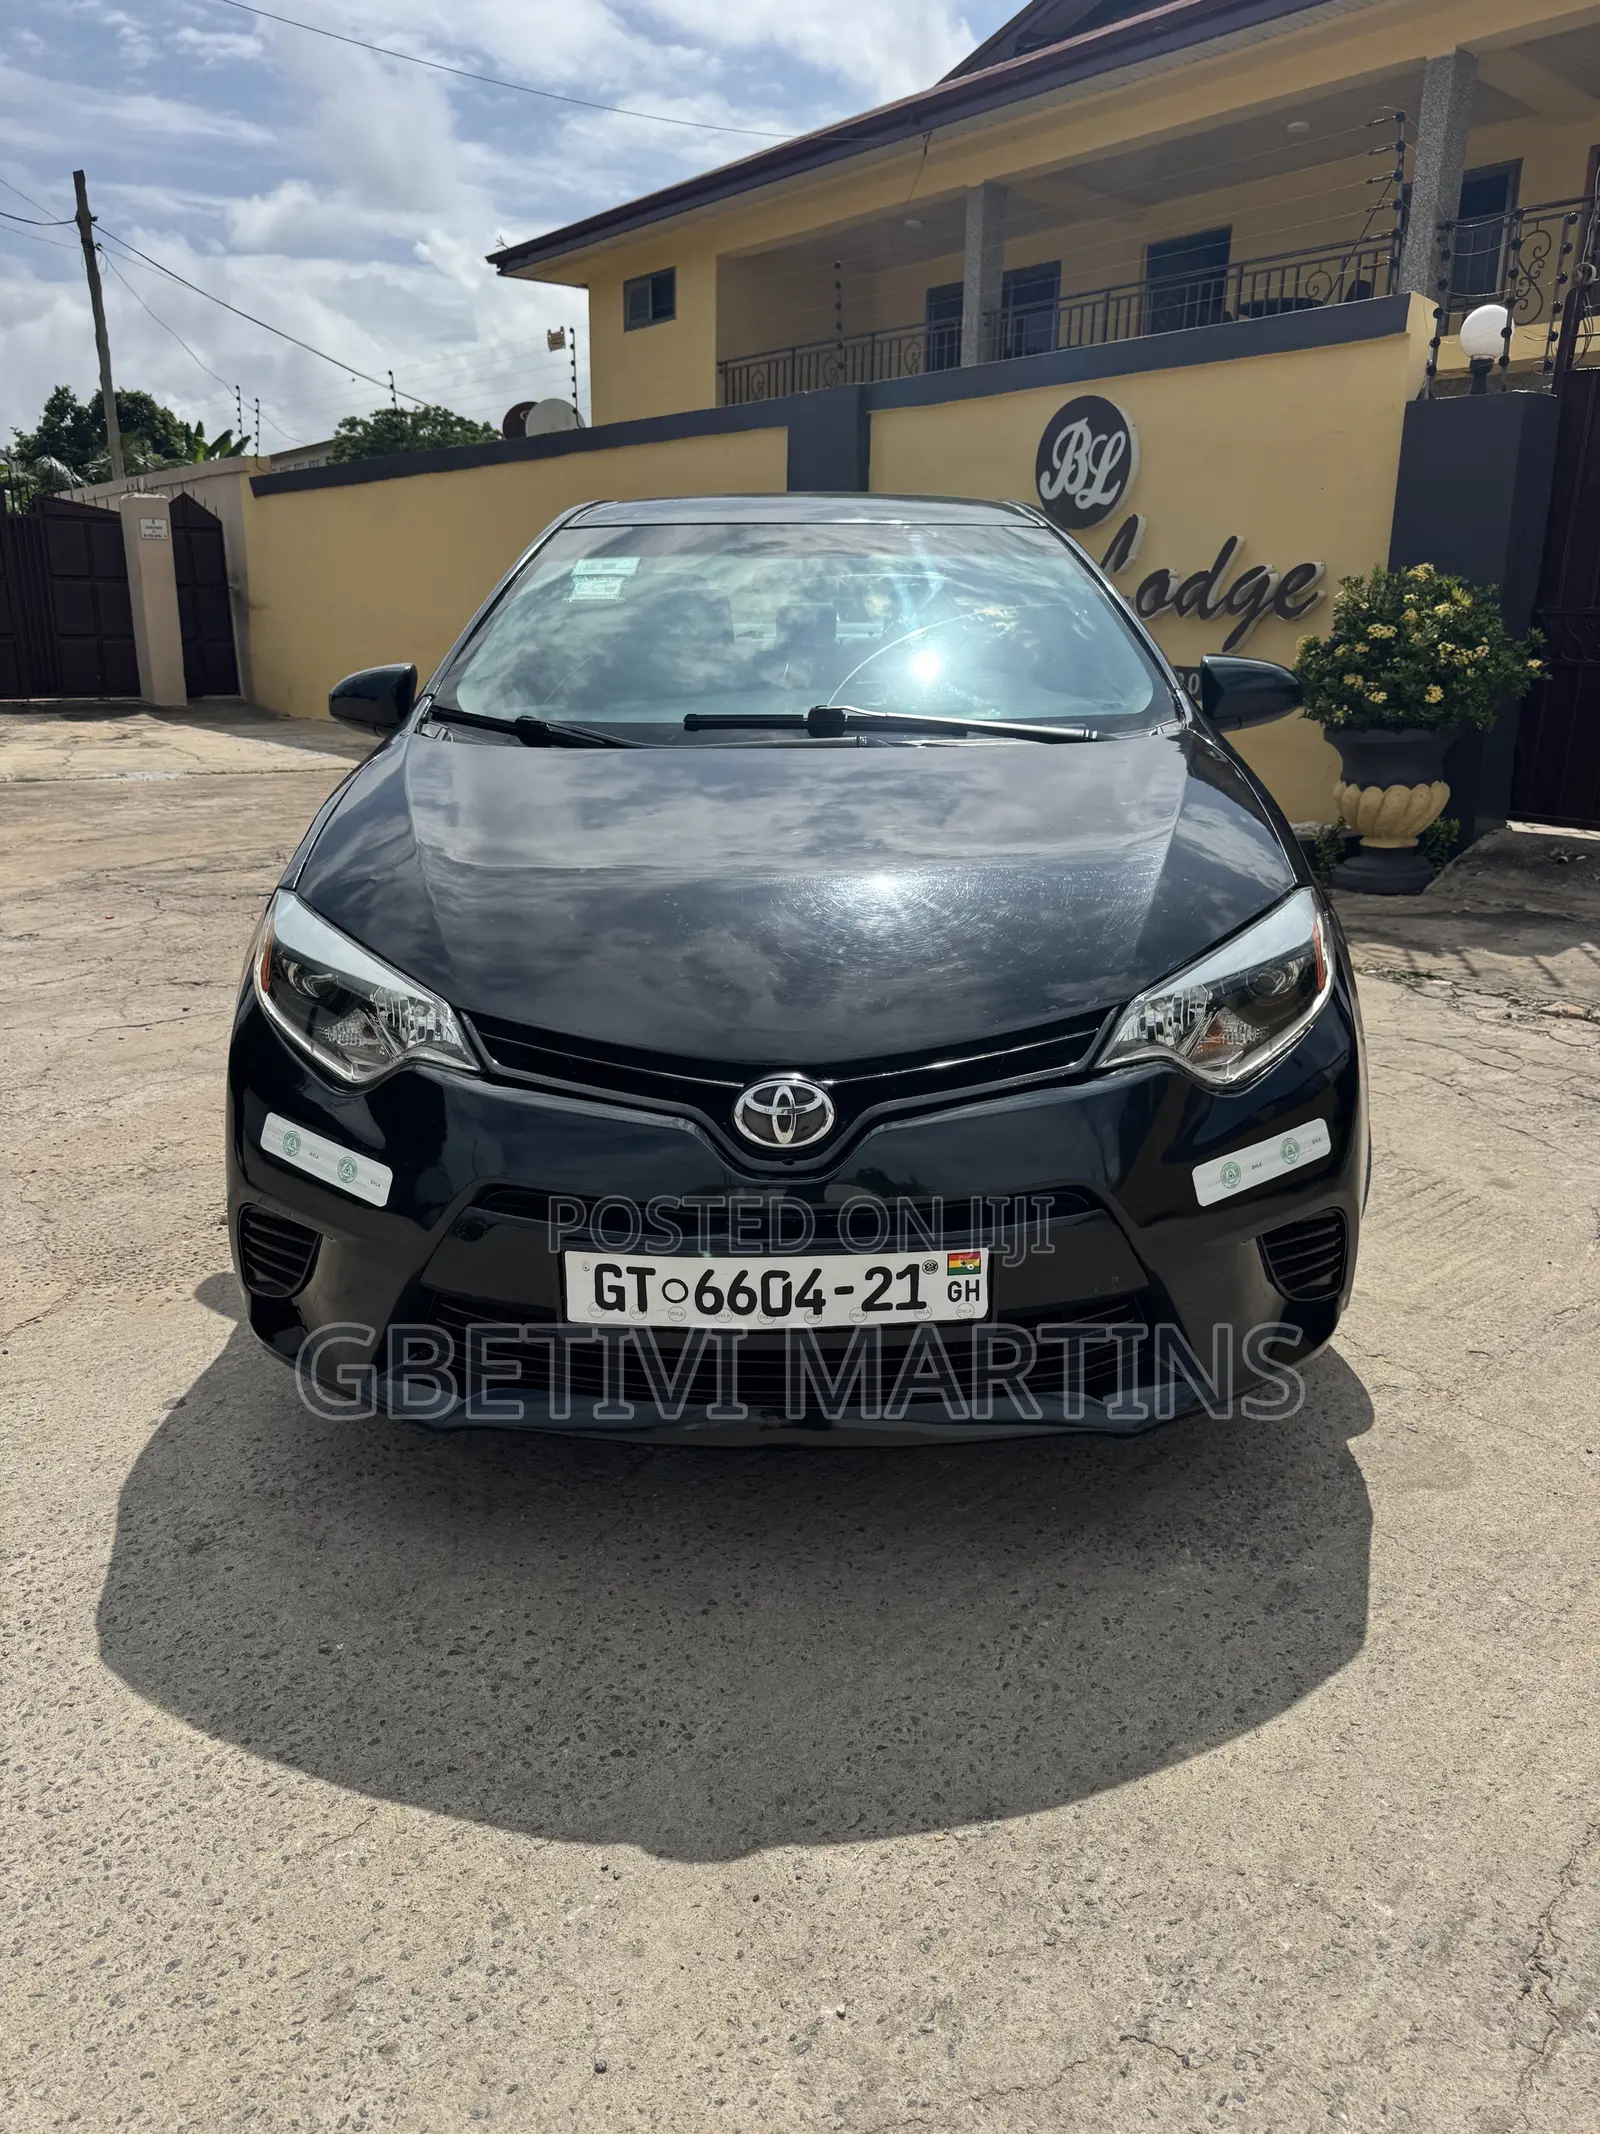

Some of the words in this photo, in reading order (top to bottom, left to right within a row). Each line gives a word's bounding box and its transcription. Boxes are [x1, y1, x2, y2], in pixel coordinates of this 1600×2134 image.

[1039, 417, 1126, 509] BL
[594, 1263, 656, 1312] GT
[694, 1263, 927, 1318] 6604-21
[947, 1279, 980, 1303] GH
